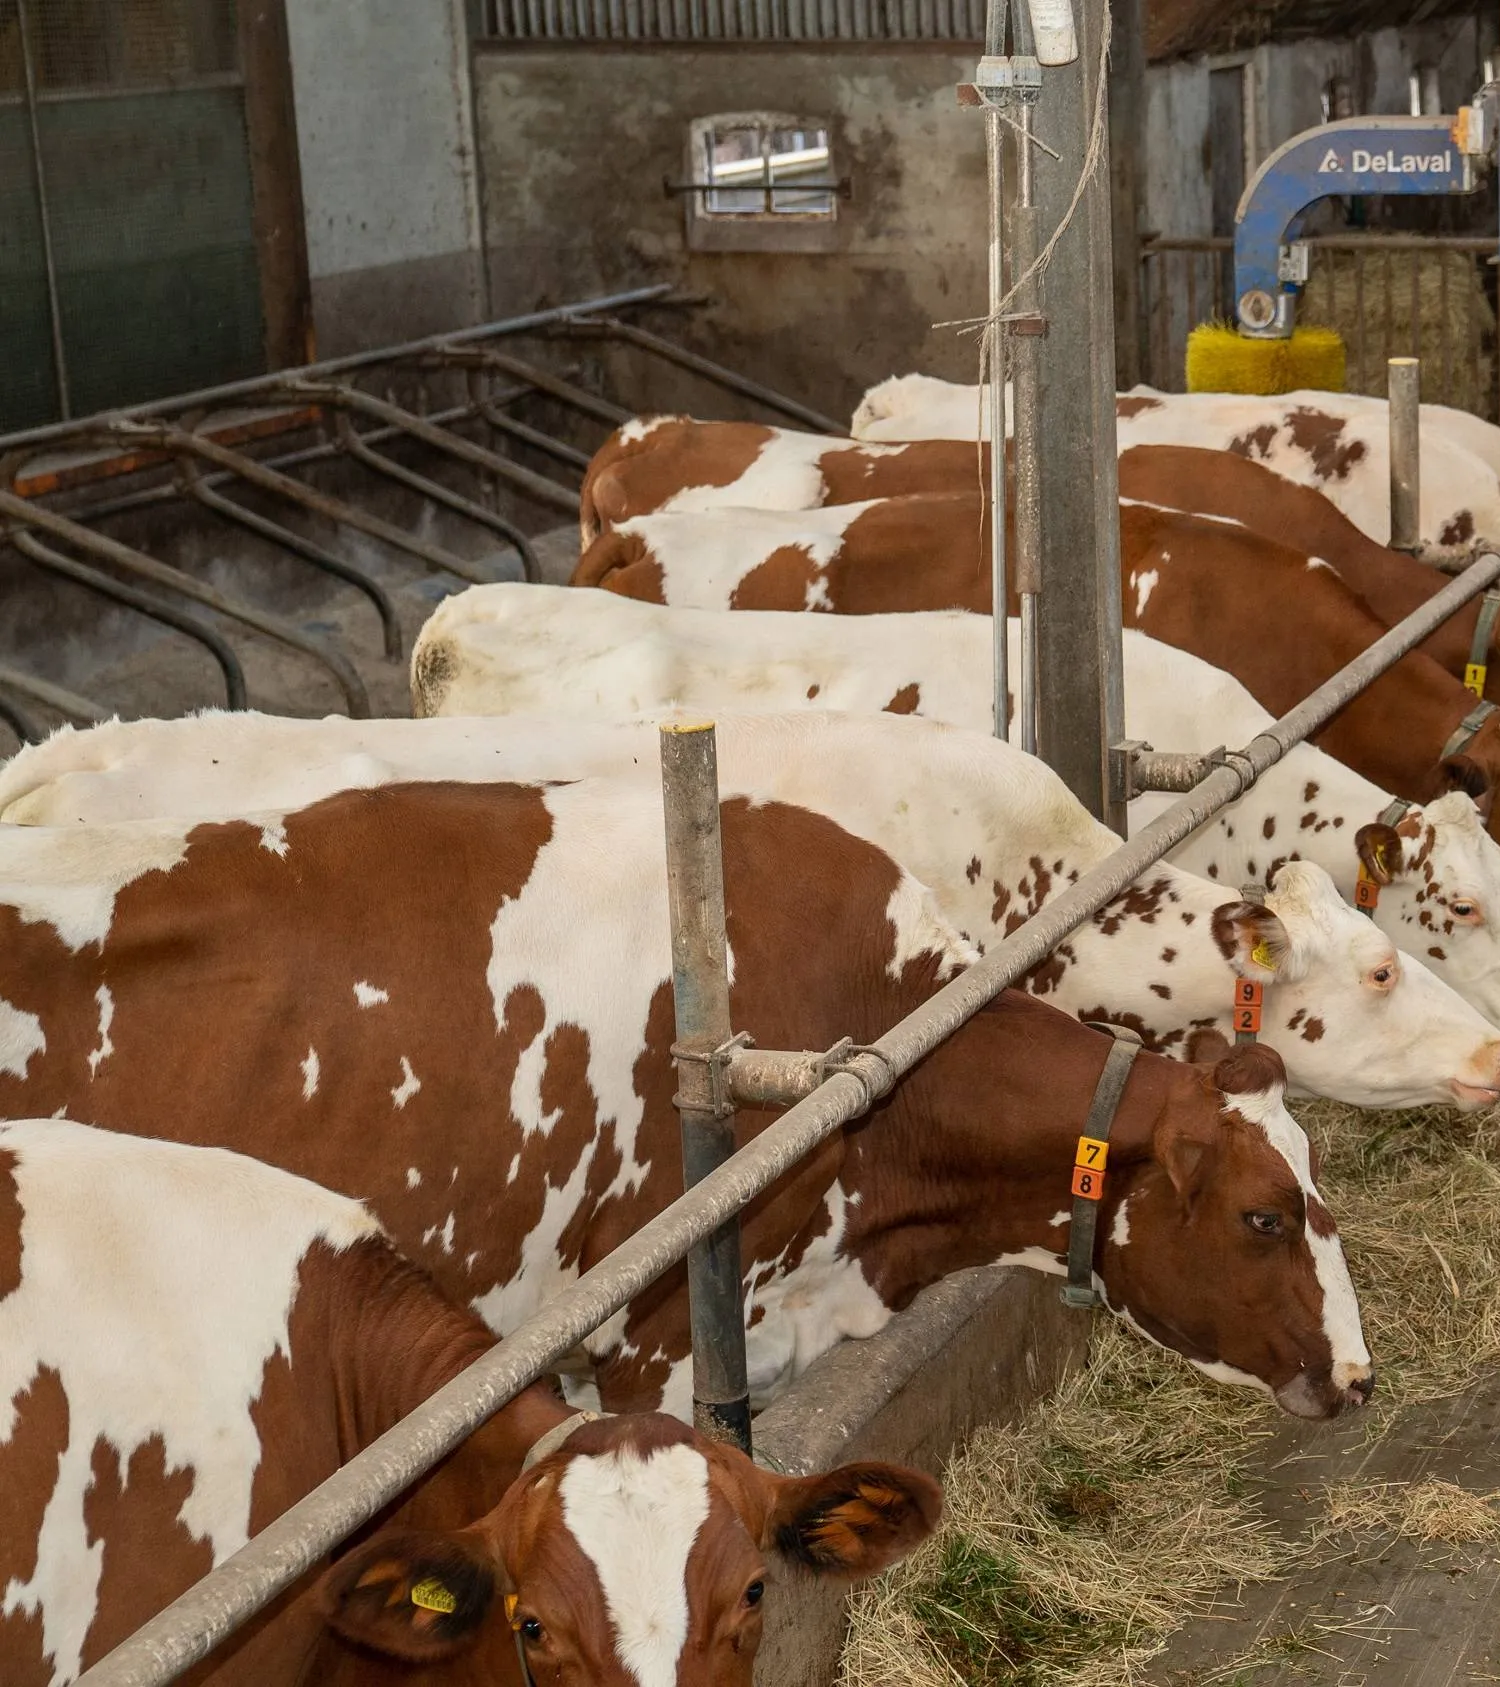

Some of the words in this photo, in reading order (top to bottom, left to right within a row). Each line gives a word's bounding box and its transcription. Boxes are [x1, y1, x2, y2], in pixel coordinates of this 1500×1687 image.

[1352, 149, 1451, 173] DeLaval
[1472, 669, 1478, 680] 1
[1361, 887, 1369, 903] 9
[1243, 983, 1254, 1001] 9
[1241, 1011, 1252, 1028] 2
[1086, 1144, 1100, 1164] 7
[1080, 1174, 1092, 1193] 8
